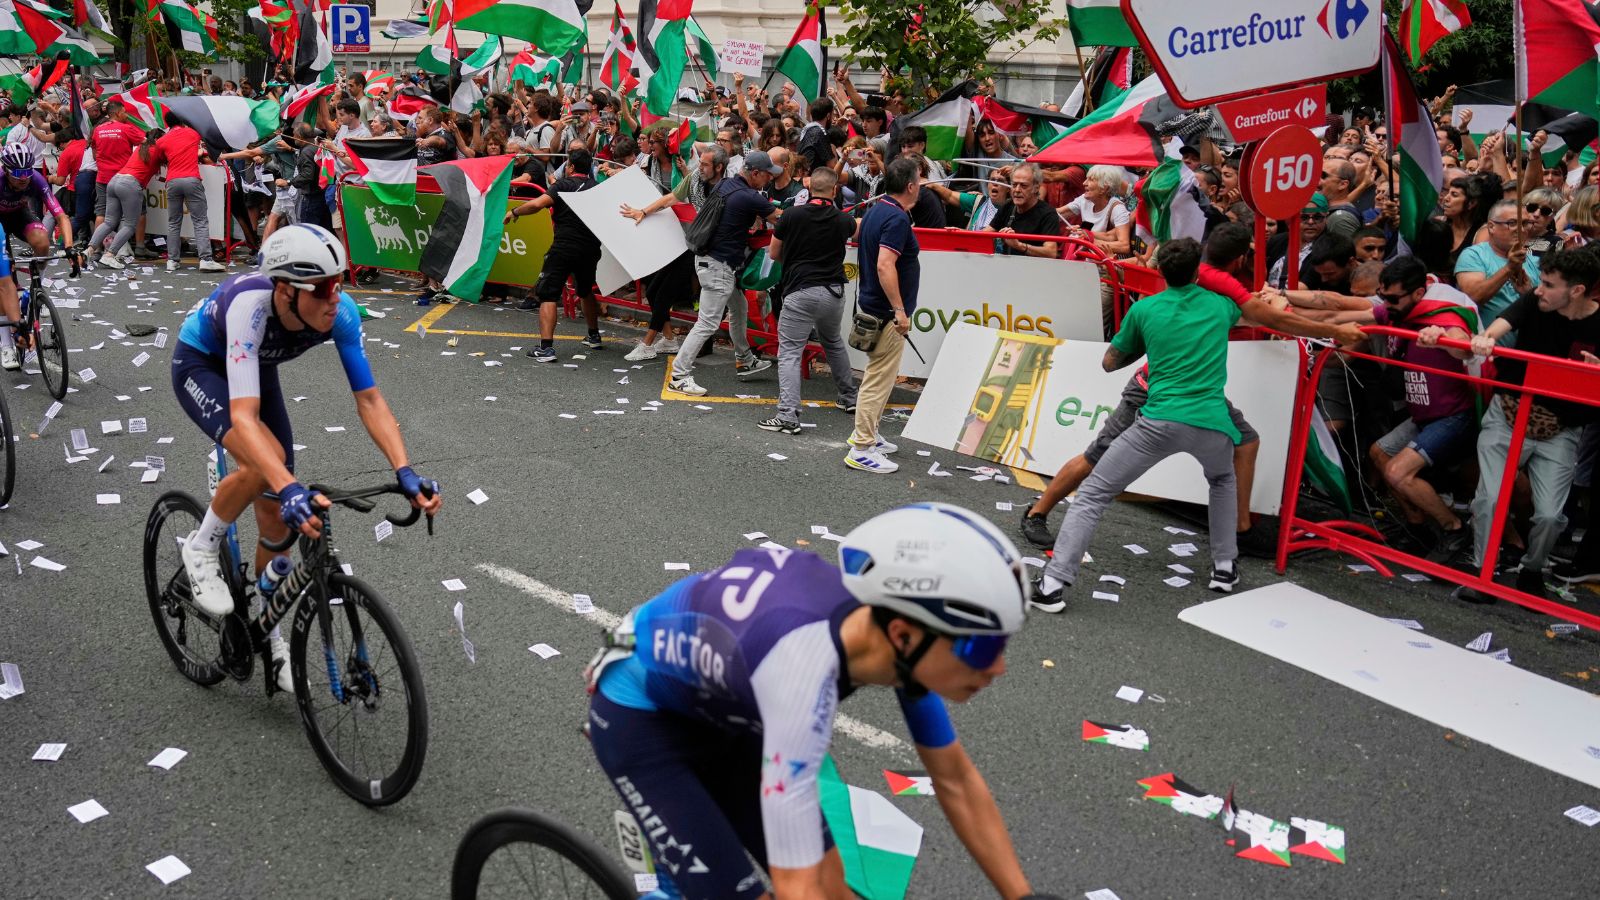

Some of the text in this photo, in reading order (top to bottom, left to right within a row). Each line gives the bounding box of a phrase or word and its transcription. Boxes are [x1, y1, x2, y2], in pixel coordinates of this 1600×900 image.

[339, 7, 362, 44] P
[726, 40, 746, 48] SYLVAN
[1168, 13, 1306, 58] Carrefour
[1235, 108, 1291, 129] Carrefour
[1263, 153, 1314, 193] 150
[184, 376, 206, 410] ISRAEL
[259, 562, 312, 634] FACTOR
[653, 627, 729, 690] FACTOR
[615, 775, 669, 842] ISRAEL
